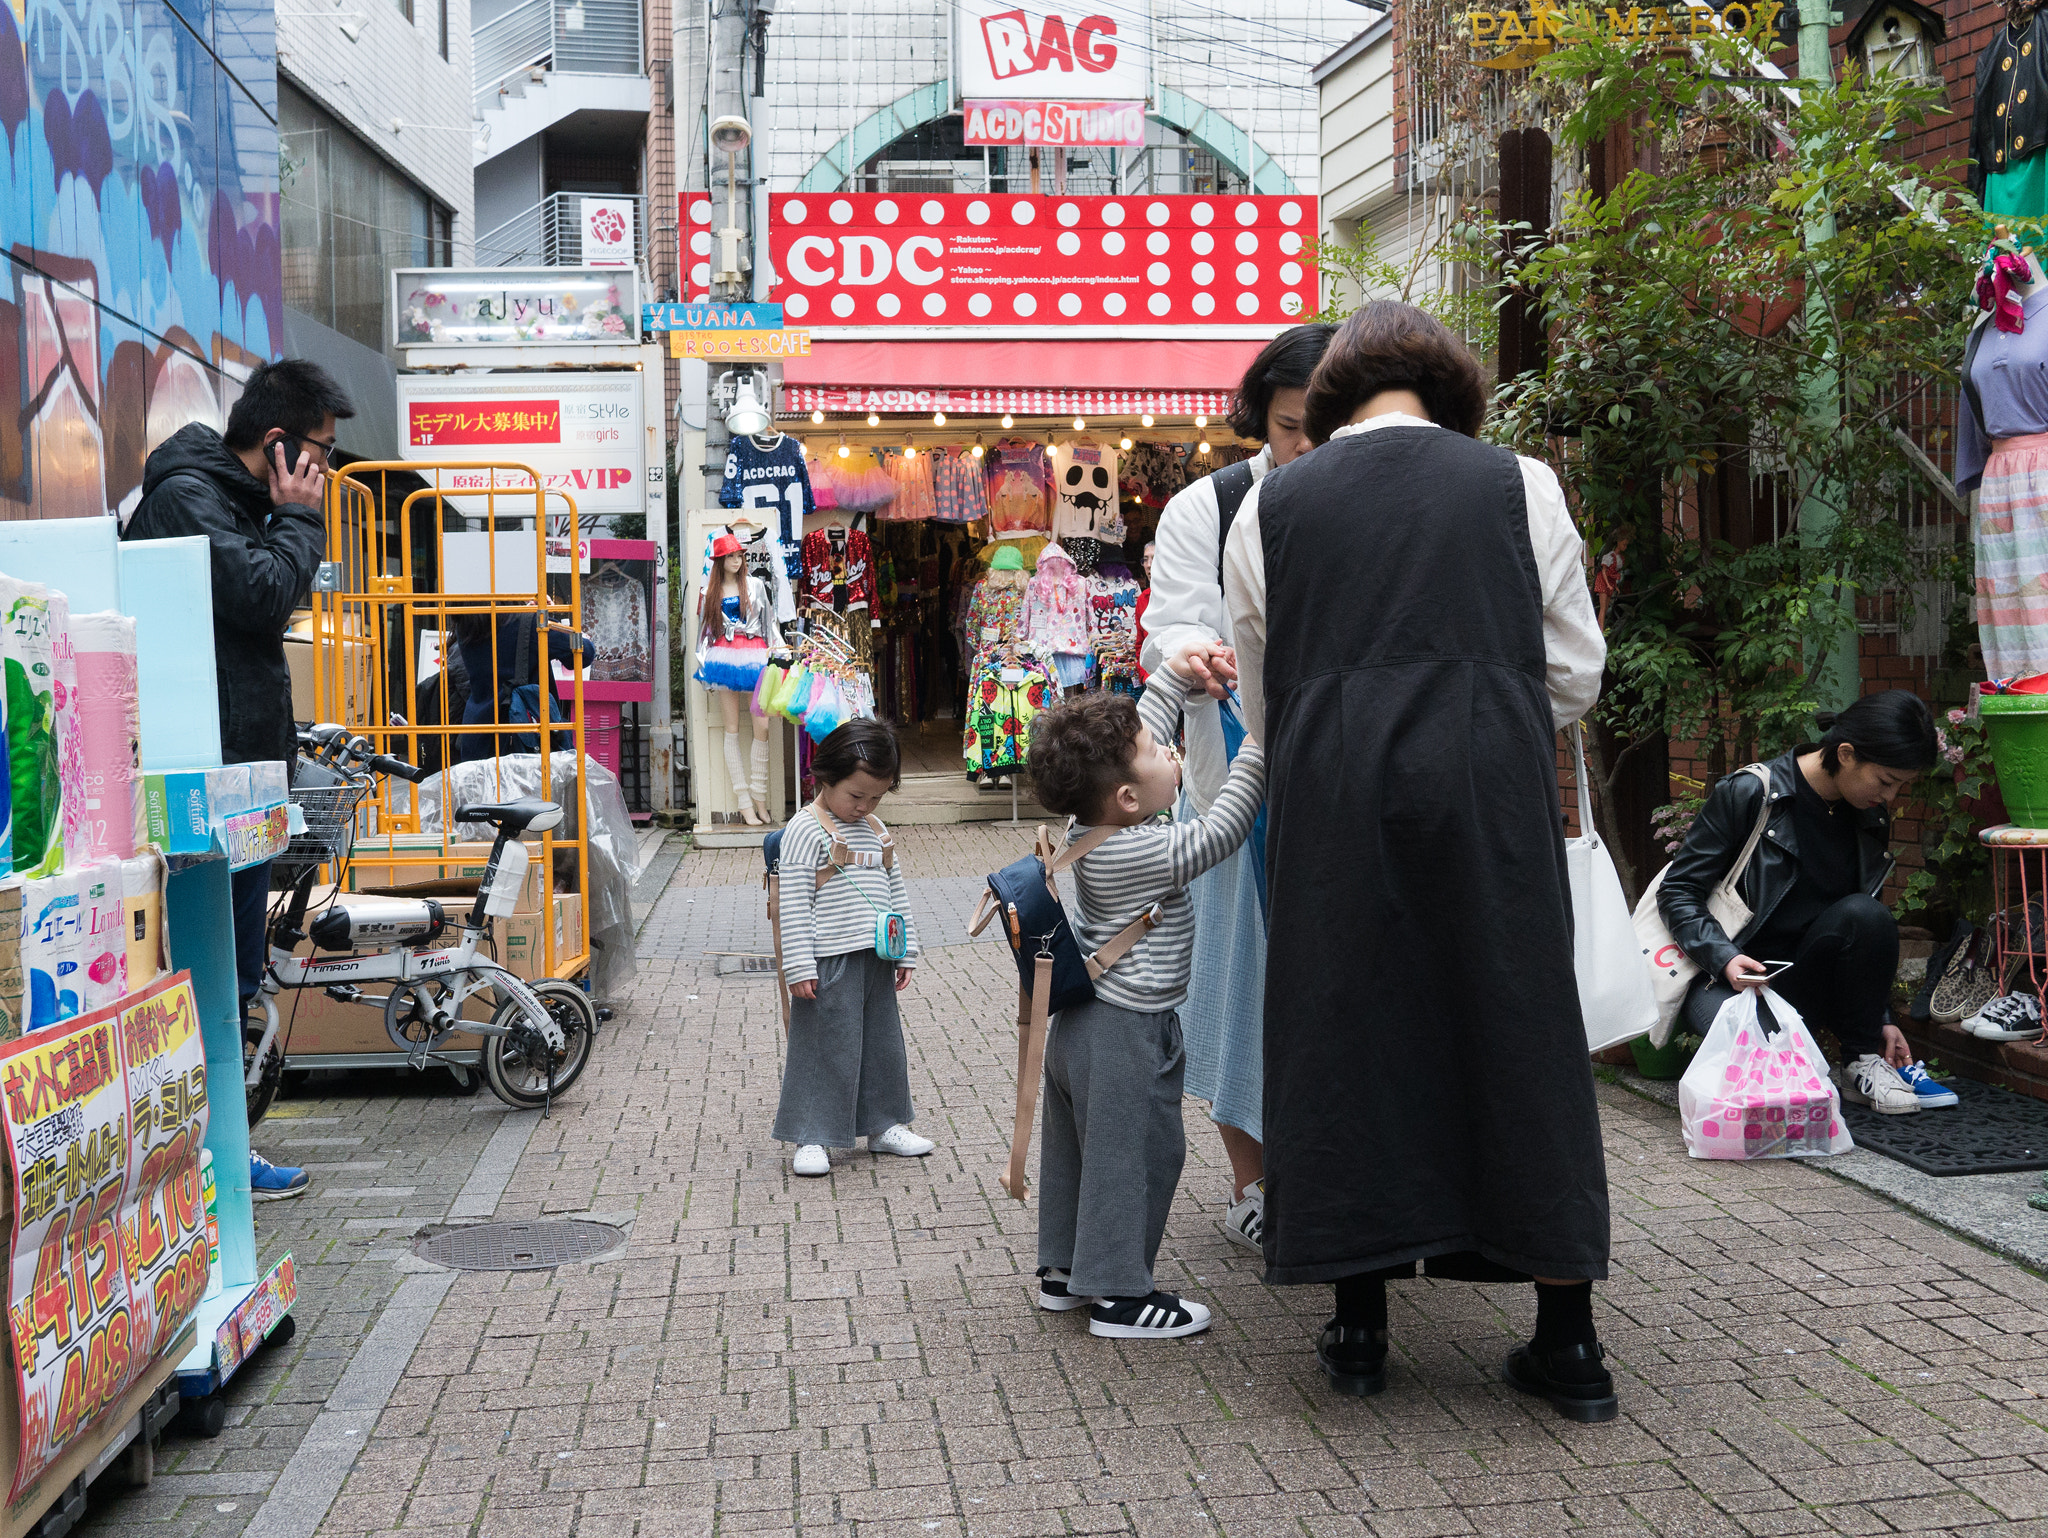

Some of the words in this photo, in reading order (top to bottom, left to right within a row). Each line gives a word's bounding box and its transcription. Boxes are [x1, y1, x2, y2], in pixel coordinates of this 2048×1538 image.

[980, 9, 1118, 80] RAG
[769, 235, 944, 286] CDC
[949, 245, 1042, 255] rakuten.co.jp/acdcrag/
[950, 275, 1140, 285] store.shopping.yahoo.co.jp/acdcrag/index.html
[669, 308, 756, 327] LUANA
[767, 332, 810, 355] CAFE
[864, 391, 931, 405] ACDC
[412, 410, 558, 433] モデル大募集中!
[421, 434, 434, 445] 1F
[596, 427, 619, 443] girls
[571, 467, 632, 489] VIP
[742, 465, 796, 480] ACDCRAG
[745, 552, 771, 563] CRAG
[149, 790, 166, 838] Softimo
[190, 788, 208, 836] Softimo
[89, 819, 108, 847] 12
[4, 1024, 120, 1125] ホントに高品質!
[130, 1055, 174, 1102] MKL
[1727, 1108, 1825, 1121] DAISO
[17, 1102, 84, 1164] 大王製紙
[152, 1235, 208, 1358] 298
[50, 1306, 134, 1450] 448
